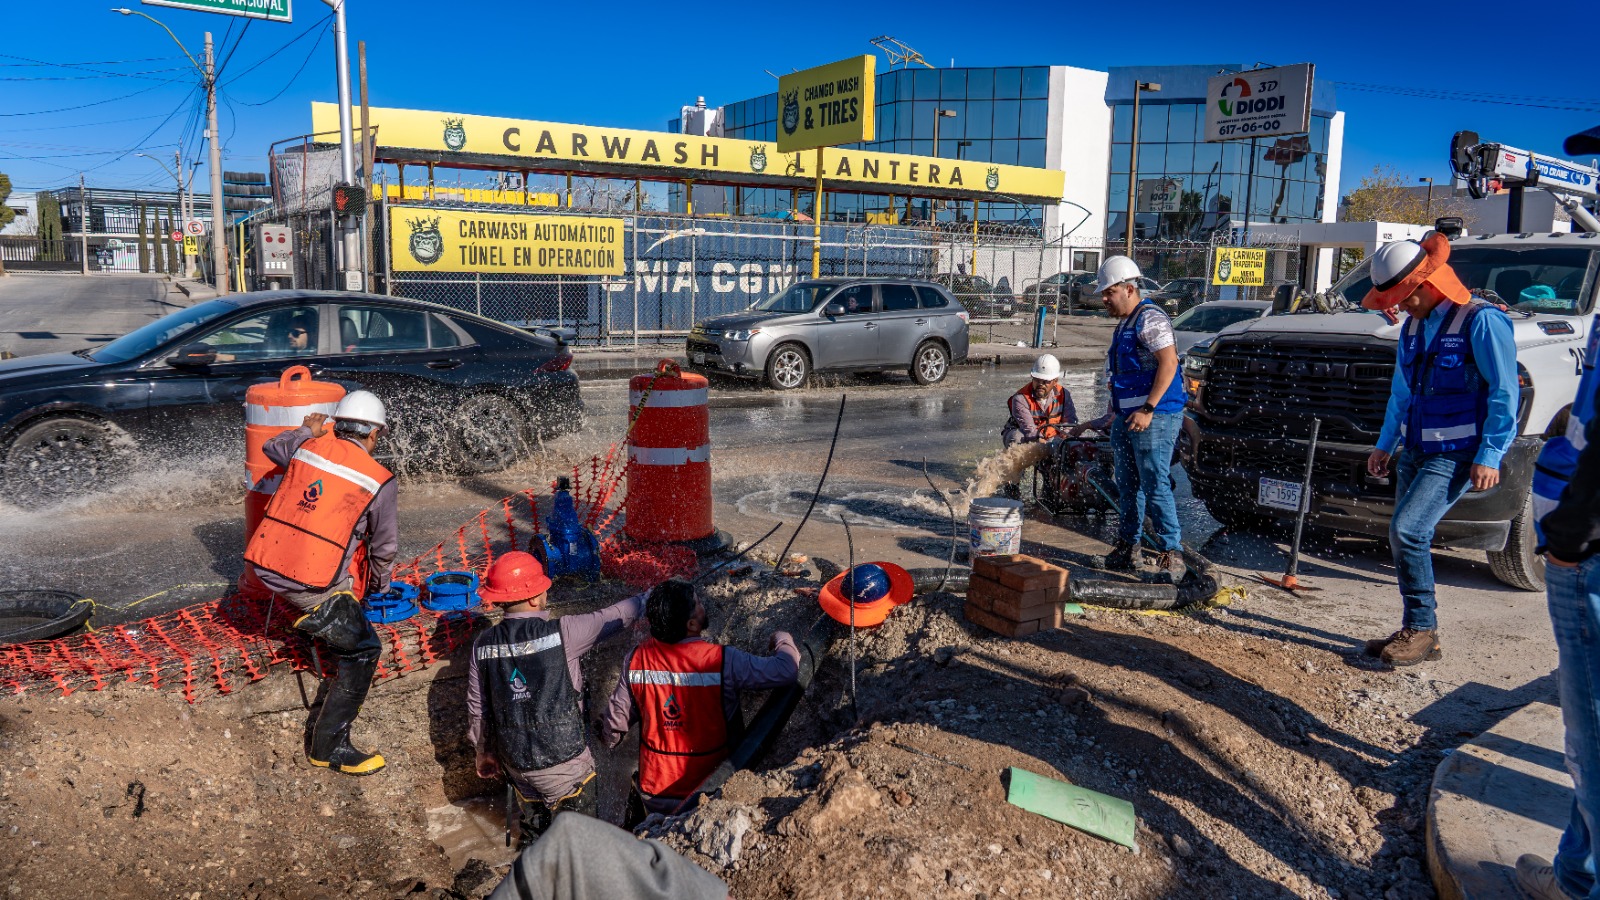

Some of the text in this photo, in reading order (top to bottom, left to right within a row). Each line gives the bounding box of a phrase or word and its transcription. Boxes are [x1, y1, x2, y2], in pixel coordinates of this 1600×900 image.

[804, 76, 859, 102] CHANGO WASH
[1258, 80, 1279, 93] 3D
[804, 96, 859, 130] & TIRES
[1236, 95, 1286, 115] DIODI
[1219, 119, 1281, 136] 617-06-00
[502, 127, 964, 186] CARWASH LANTERA
[1549, 167, 1570, 180] CRANE
[458, 219, 615, 244] CARWASH AUTOMÁTICO
[458, 241, 615, 269] TÚNEL EN OPERACIÓN
[1233, 250, 1264, 260] CARWASH
[711, 262, 799, 294] CGM
[1250, 360, 1348, 378] RAM
